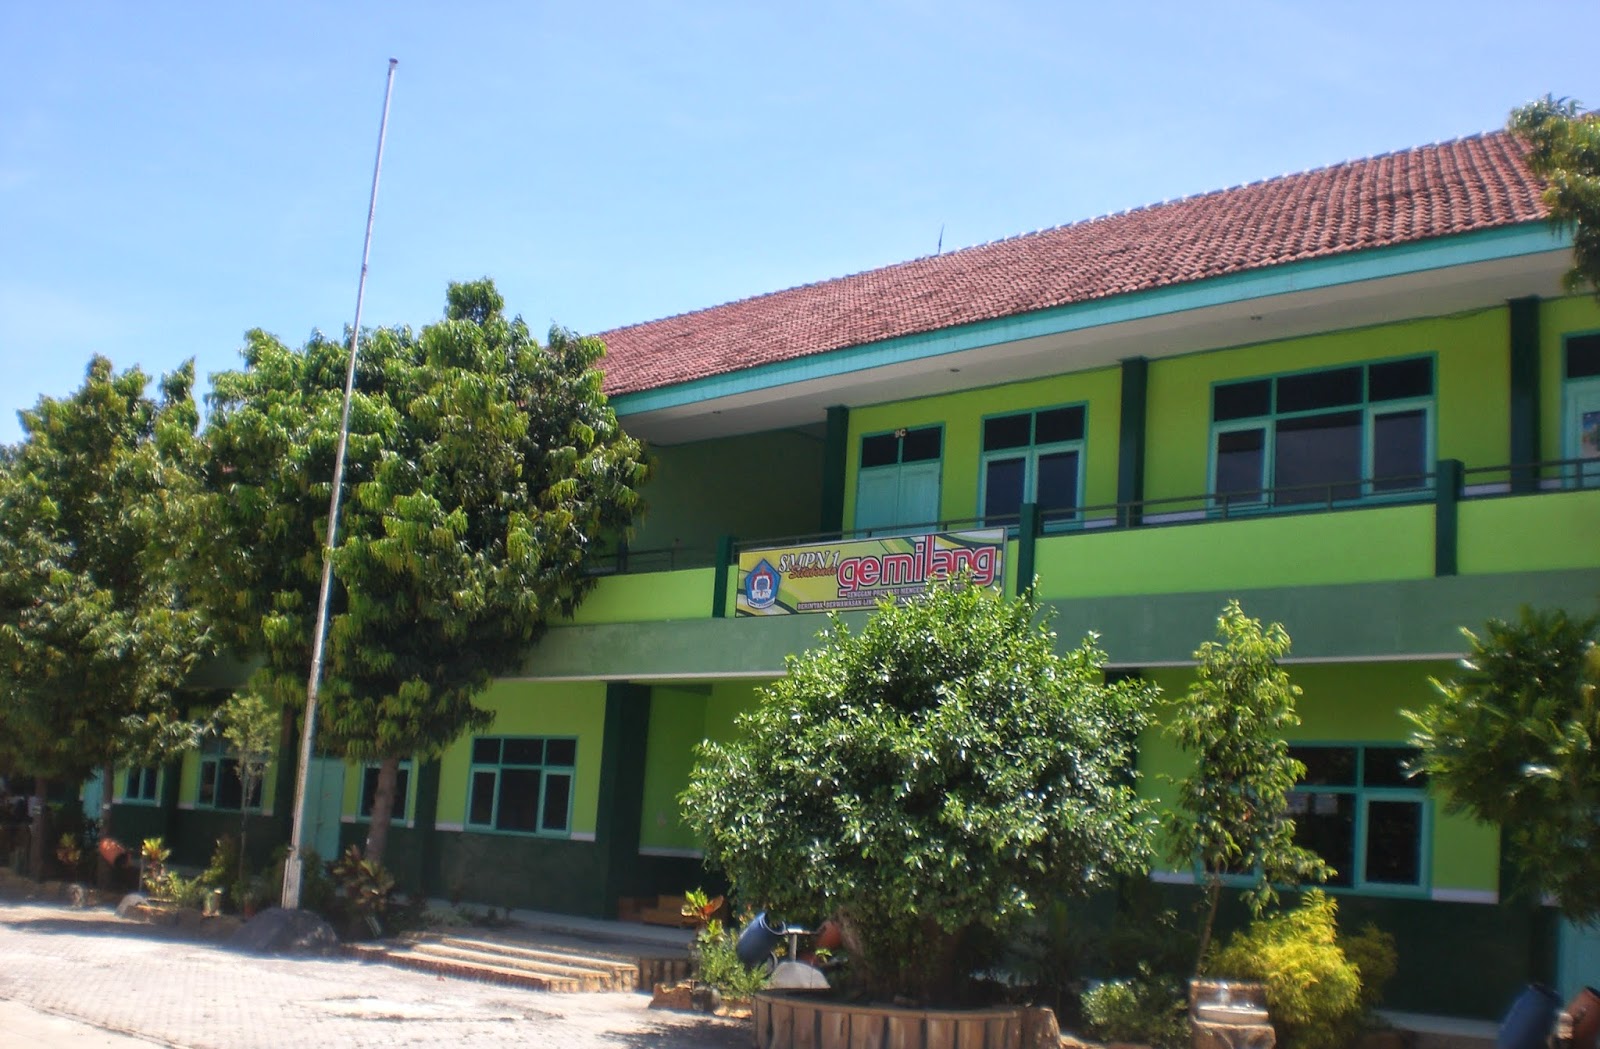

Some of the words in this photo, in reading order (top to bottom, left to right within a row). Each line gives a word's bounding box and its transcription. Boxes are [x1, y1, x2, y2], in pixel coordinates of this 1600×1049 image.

[779, 551, 830, 573] SMPN
[832, 550, 840, 568] 1
[836, 534, 997, 597] gemilang
